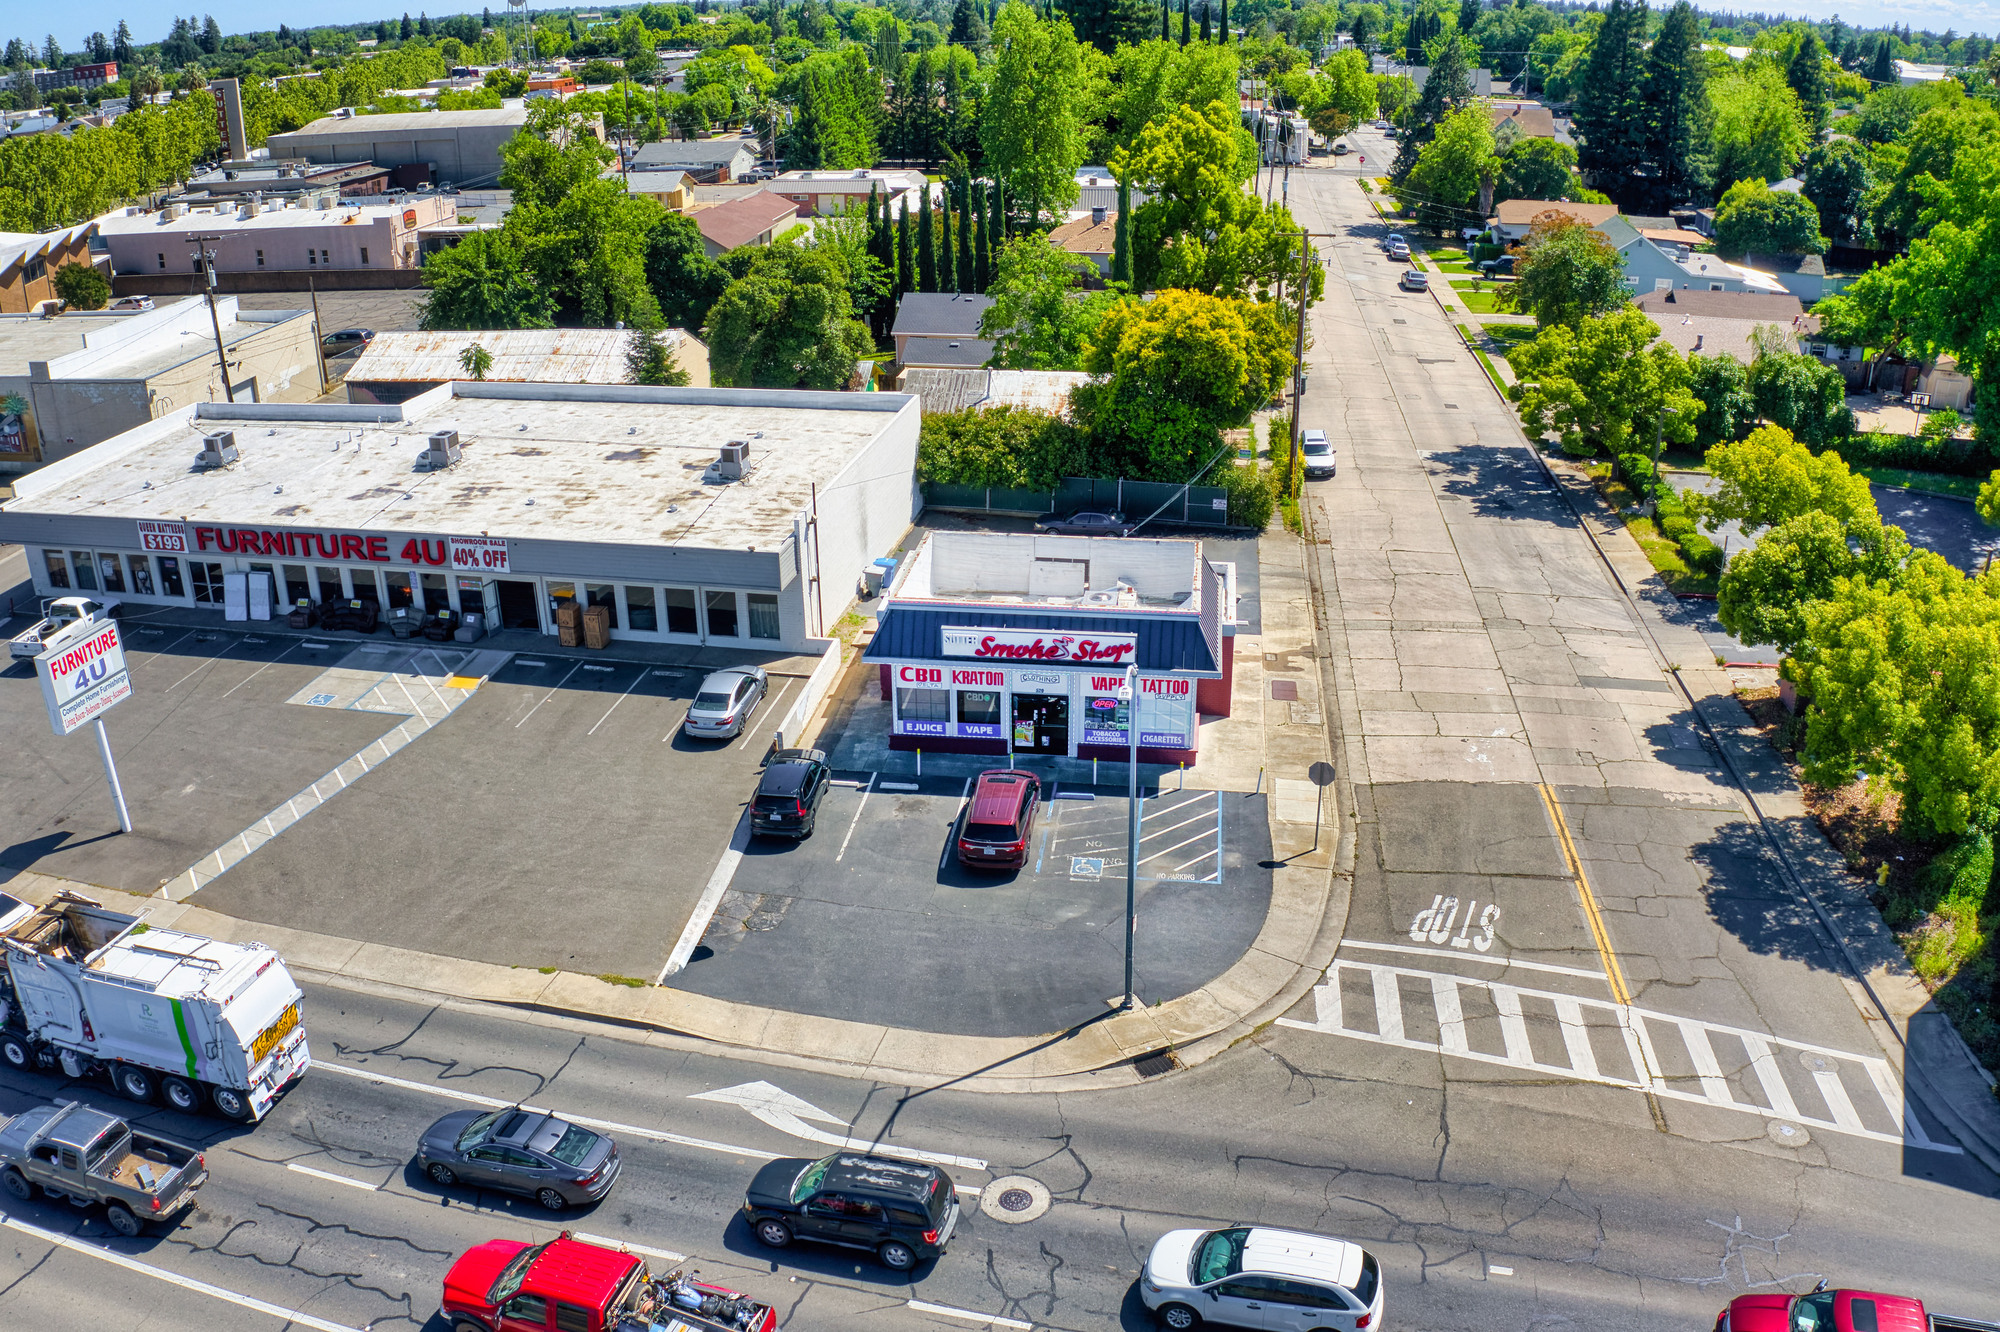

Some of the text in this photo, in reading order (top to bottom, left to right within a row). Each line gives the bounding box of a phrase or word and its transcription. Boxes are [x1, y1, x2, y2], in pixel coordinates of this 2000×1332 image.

[215, 90, 228, 149] SUTTER
[138, 522, 185, 534] QUEEN MATTRESS
[147, 535, 181, 550] $199
[195, 527, 447, 566] FURNITURE 4U
[489, 539, 506, 547] SALE
[453, 548, 507, 568] 40% OFF
[50, 628, 118, 681] FURNITURE
[944, 632, 1135, 664] SUTTER Smoke Shop
[75, 657, 107, 690] 4U
[900, 667, 942, 683] CBD
[952, 670, 1004, 686] KRATOM
[1022, 674, 1058, 683] CLOTHING
[1091, 676, 1126, 691] VAPE
[1140, 678, 1189, 695] TATTOO
[62, 674, 127, 717] Complete Home Furnishings
[966, 692, 984, 702] CBD
[1094, 700, 1115, 708] OPEN
[906, 723, 943, 732] E JUICE
[965, 725, 993, 735] VAPE
[1086, 735, 1127, 743] ACCESSORIES
[1142, 735, 1182, 744] CIGARETTES
[1155, 872, 1196, 881] NO PARKING
[1409, 894, 1500, 952] STOP
[260, 1018, 289, 1049] CAUTION
